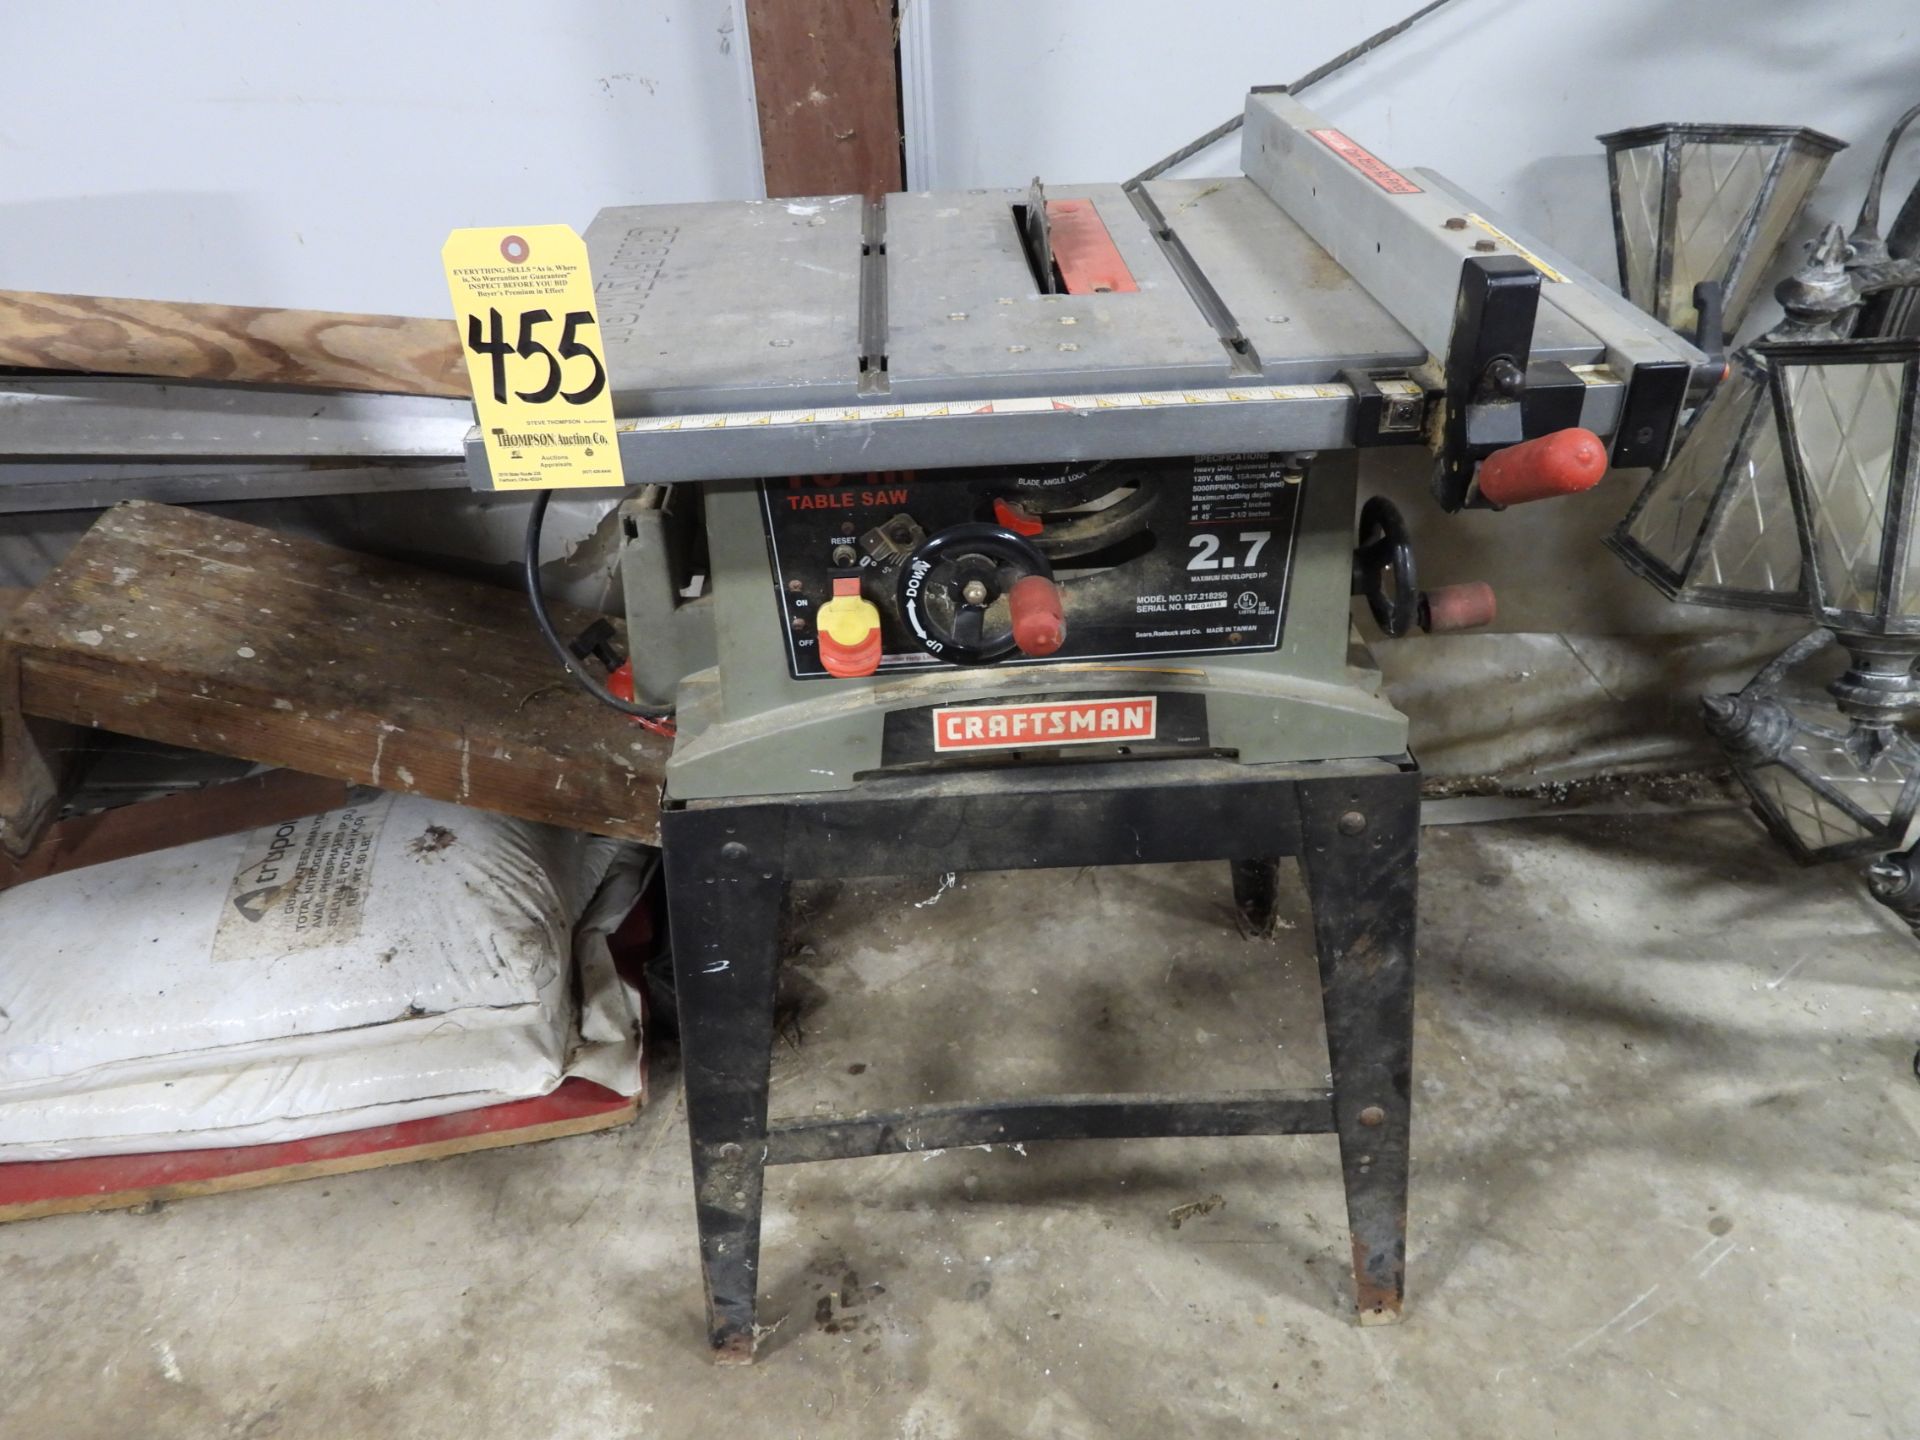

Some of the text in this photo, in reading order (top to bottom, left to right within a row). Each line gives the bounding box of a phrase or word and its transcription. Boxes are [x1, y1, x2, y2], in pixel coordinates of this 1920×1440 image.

[453, 267, 505, 275] EVERYTHING
[468, 307, 606, 405] 455
[491, 428, 608, 447] THOMPSON Auction Co.
[1018, 478, 1040, 486] BLADE
[1043, 477, 1065, 485] ANGLE
[787, 489, 908, 510] TABLE SAW
[1226, 493, 1250, 501] cutting
[831, 537, 856, 545] RESET
[1186, 531, 1271, 570] 2.7
[906, 558, 932, 598] DOWN
[796, 599, 808, 607] ON
[1137, 595, 1166, 604] MODEL
[1136, 604, 1166, 613] SERIAL
[1169, 603, 1183, 611] NO.
[925, 639, 943, 653] UP
[947, 706, 1144, 741] CRAFTSMAN
[340, 838, 357, 875] POTASH
[296, 895, 312, 932] TOTAL
[304, 846, 326, 894] NITROGEN
